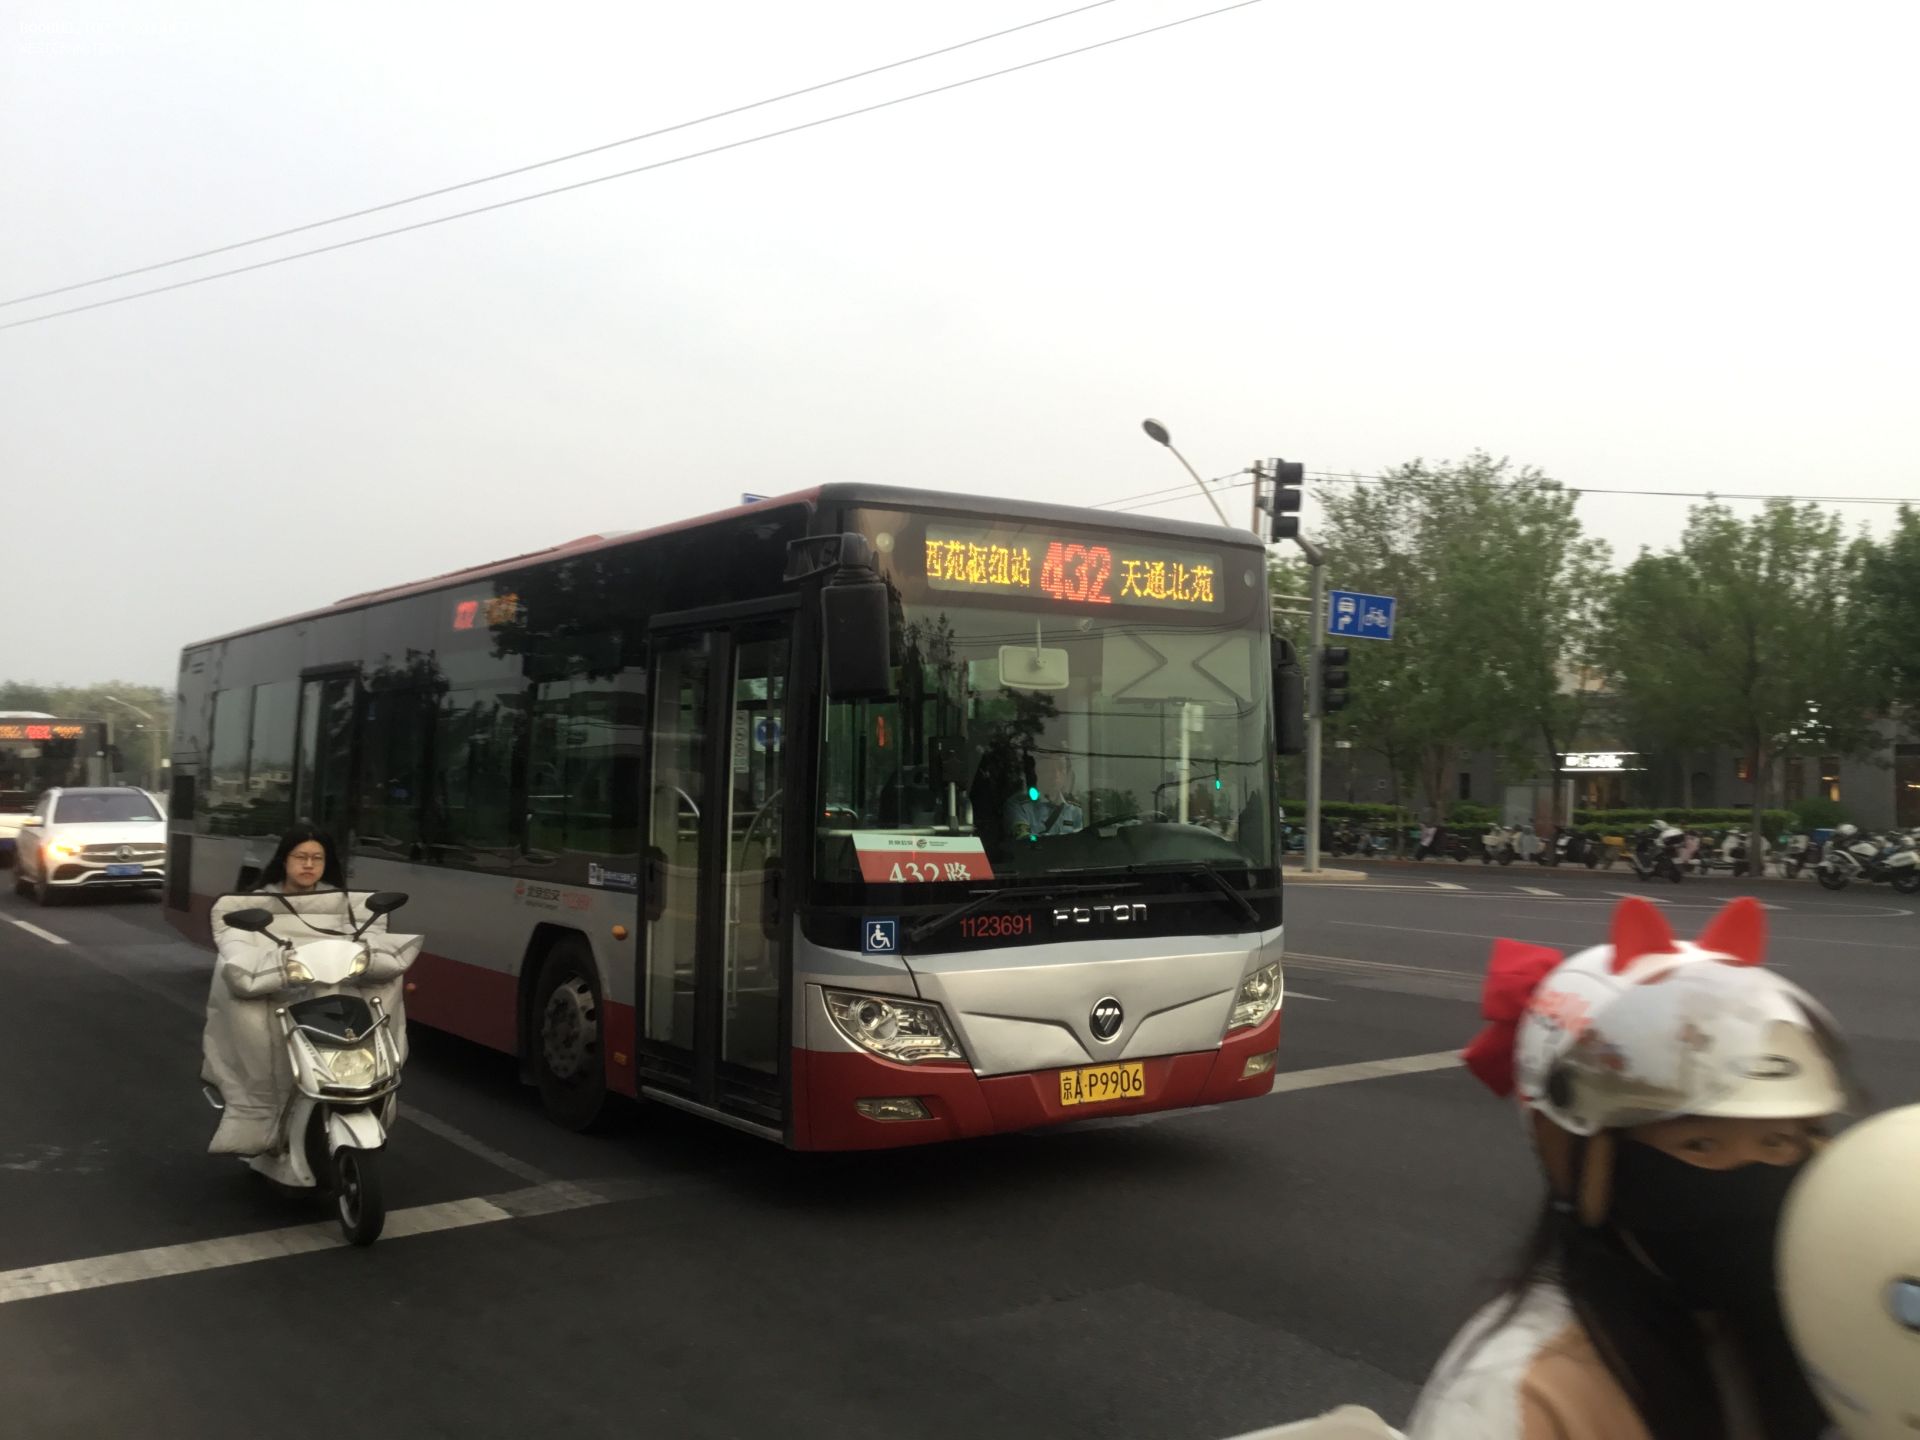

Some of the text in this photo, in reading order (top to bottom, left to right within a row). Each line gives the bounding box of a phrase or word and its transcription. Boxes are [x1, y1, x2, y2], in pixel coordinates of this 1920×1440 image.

[925, 540, 1215, 604] 西苑枢纽站 432 天通北苑
[960, 914, 1034, 938] 1123691
[1053, 903, 1147, 926] FOTON
